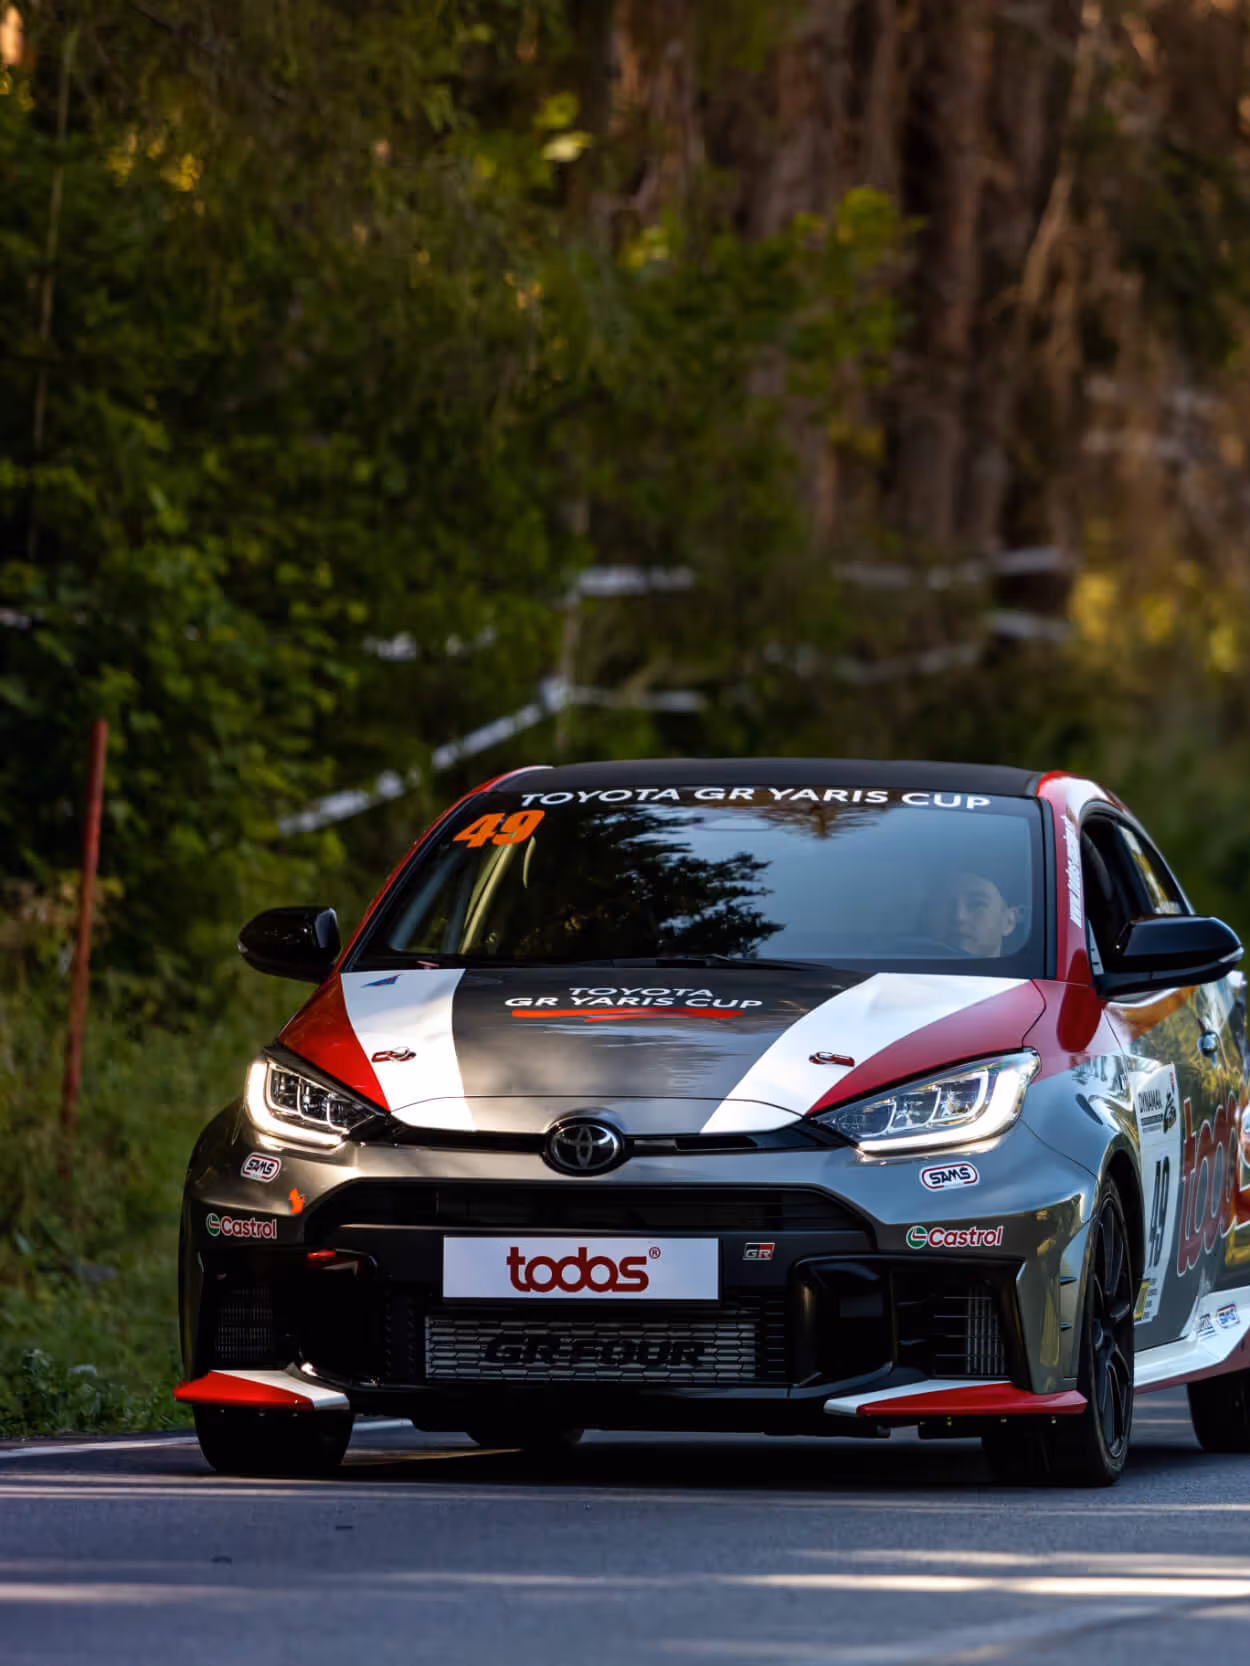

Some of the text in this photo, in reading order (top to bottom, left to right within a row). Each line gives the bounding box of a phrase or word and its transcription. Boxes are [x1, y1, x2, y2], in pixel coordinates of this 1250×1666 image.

[521, 787, 991, 809] TOYOTA GR YARIS CUP
[453, 809, 545, 848] 49
[568, 987, 715, 998] TOYOTA
[504, 997, 763, 1009] GR YARIS CUP
[246, 1159, 275, 1175] SAMS
[929, 1167, 971, 1185] SAMS
[220, 1216, 277, 1239] Castrol
[928, 1226, 1004, 1247] Castrol
